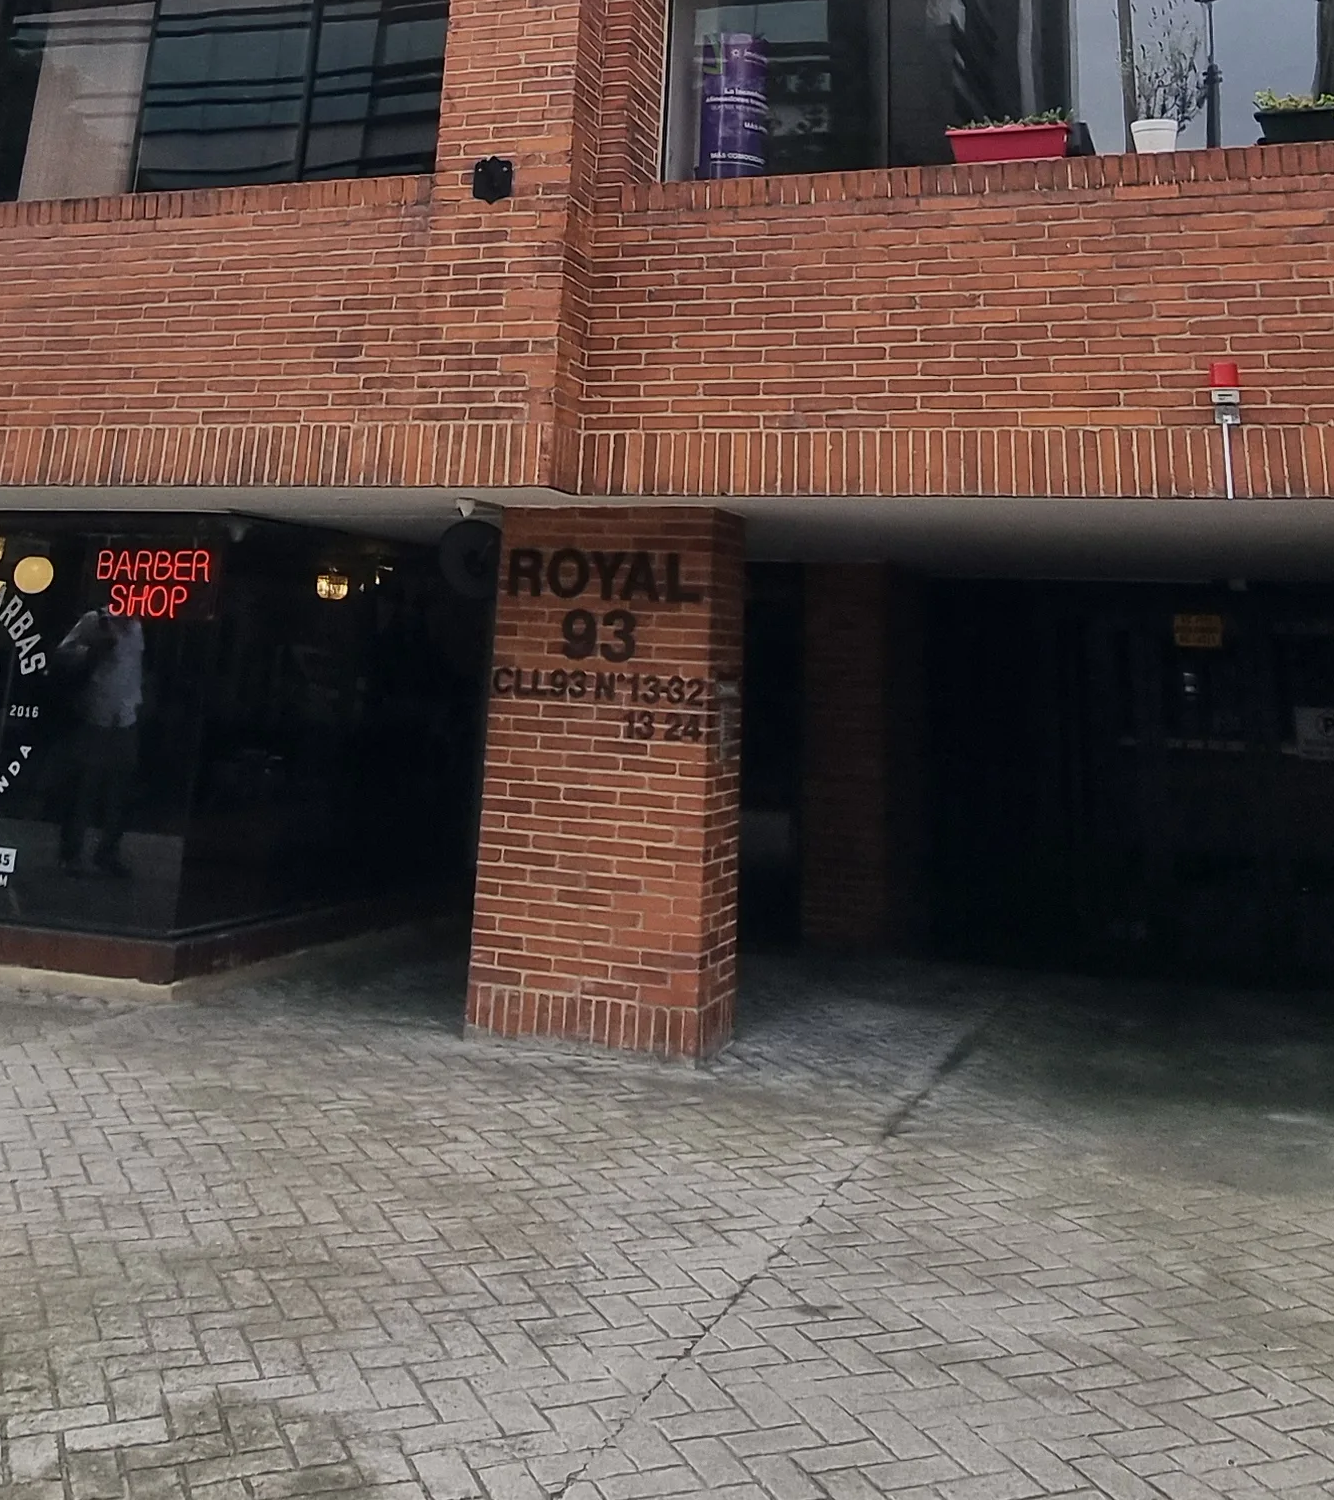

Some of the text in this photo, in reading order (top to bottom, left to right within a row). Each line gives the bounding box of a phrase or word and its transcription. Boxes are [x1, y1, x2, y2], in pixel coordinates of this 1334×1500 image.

[95, 549, 211, 583] BARBER
[507, 547, 701, 603] ROYAL
[108, 584, 188, 619] SHOP
[562, 608, 637, 663] 93
[9, 704, 39, 718] 2016
